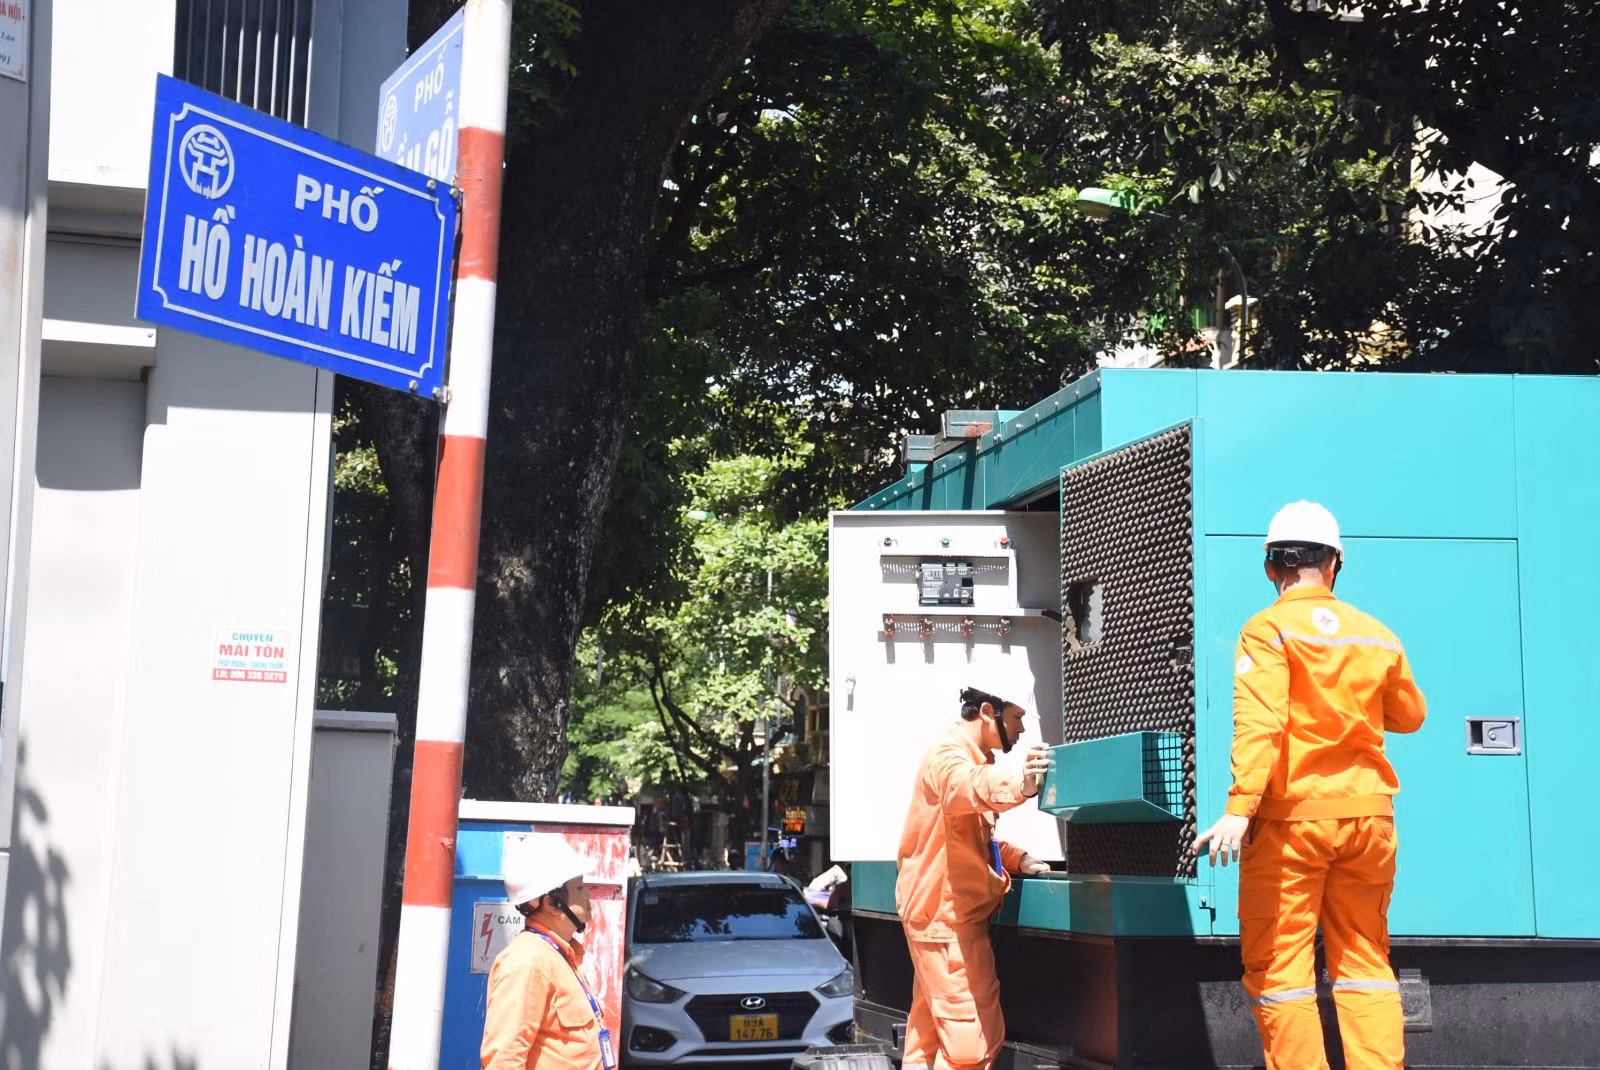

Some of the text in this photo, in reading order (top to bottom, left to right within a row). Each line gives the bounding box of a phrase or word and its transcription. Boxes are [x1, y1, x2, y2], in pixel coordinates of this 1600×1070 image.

[414, 43, 448, 113] PHỐ
[295, 173, 384, 233] PHỐ
[178, 204, 422, 355] HỒ HOÀN KIẾM
